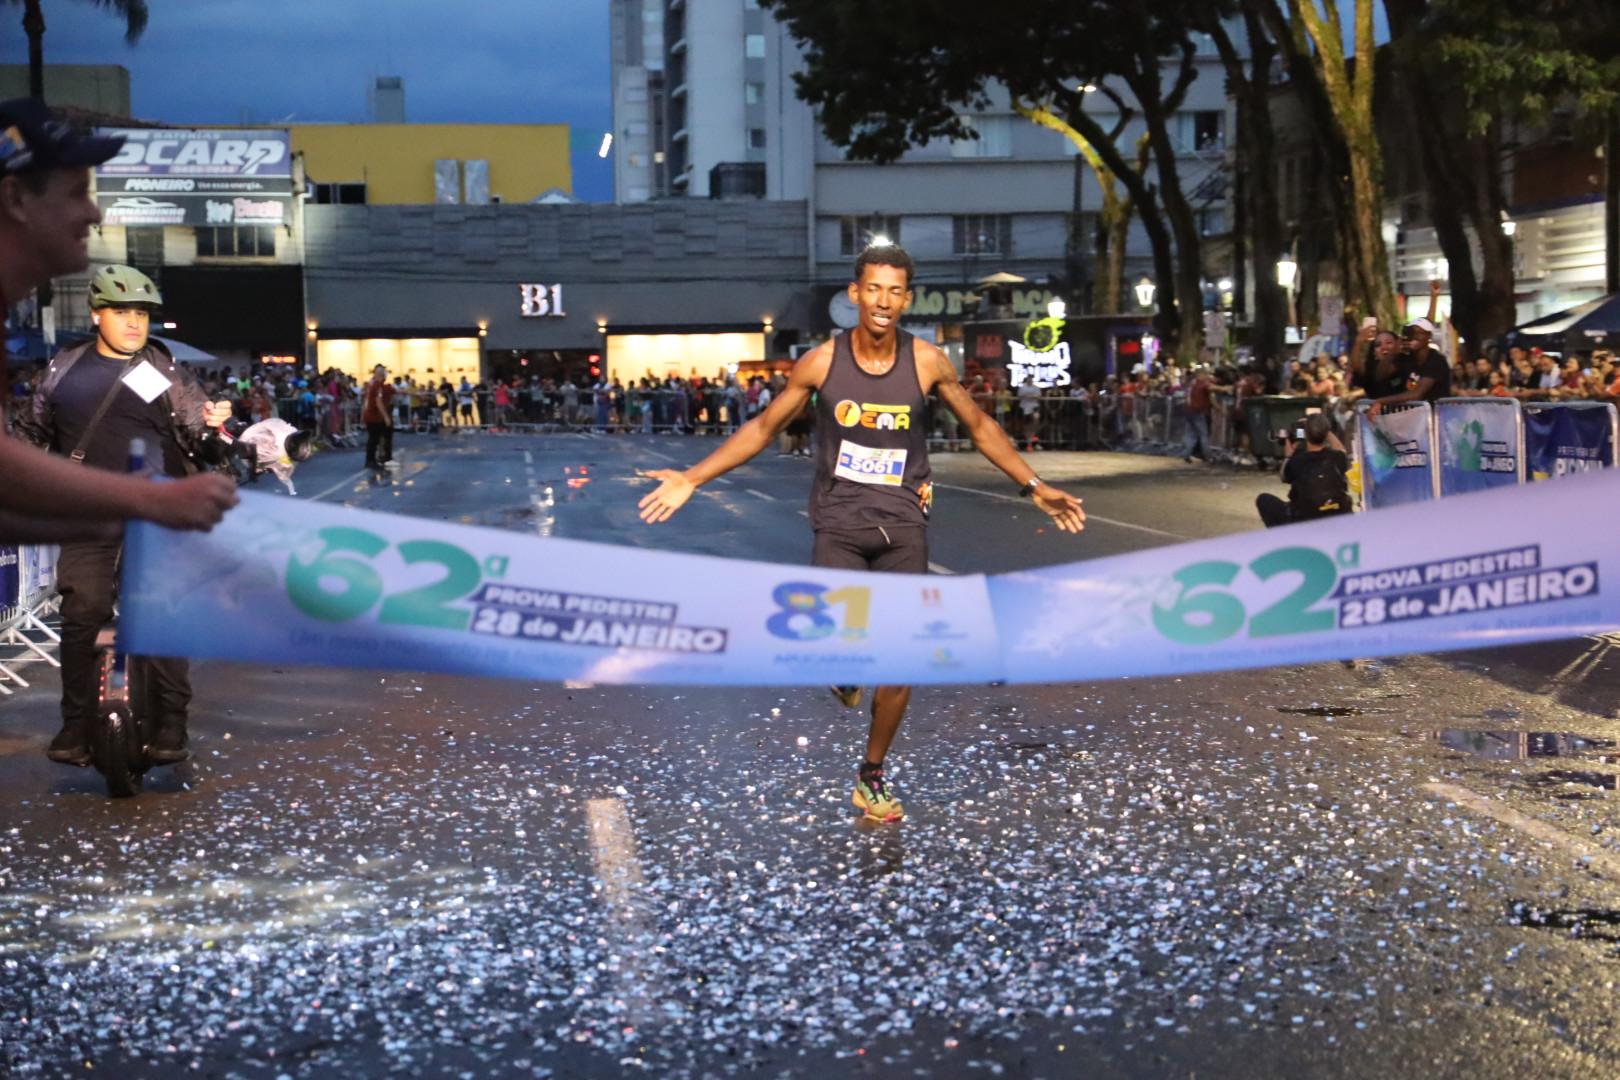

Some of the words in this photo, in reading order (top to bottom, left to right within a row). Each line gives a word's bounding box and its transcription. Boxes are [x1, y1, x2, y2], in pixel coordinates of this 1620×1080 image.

[518, 283, 566, 316] B1
[861, 411, 910, 430] EMA
[850, 457, 894, 474] 5061
[1345, 569, 1422, 594] PROVA
[1426, 549, 1537, 582] PEDESTRE
[485, 586, 561, 609] PROVA
[565, 595, 673, 619] PEDESTRE
[766, 581, 872, 642] 81
[1341, 598, 1386, 626] 28
[1390, 597, 1424, 618] de
[1429, 566, 1595, 615] JANEIRO
[474, 609, 521, 636] 28
[523, 617, 558, 637] de
[560, 619, 724, 651] JANEIRO
